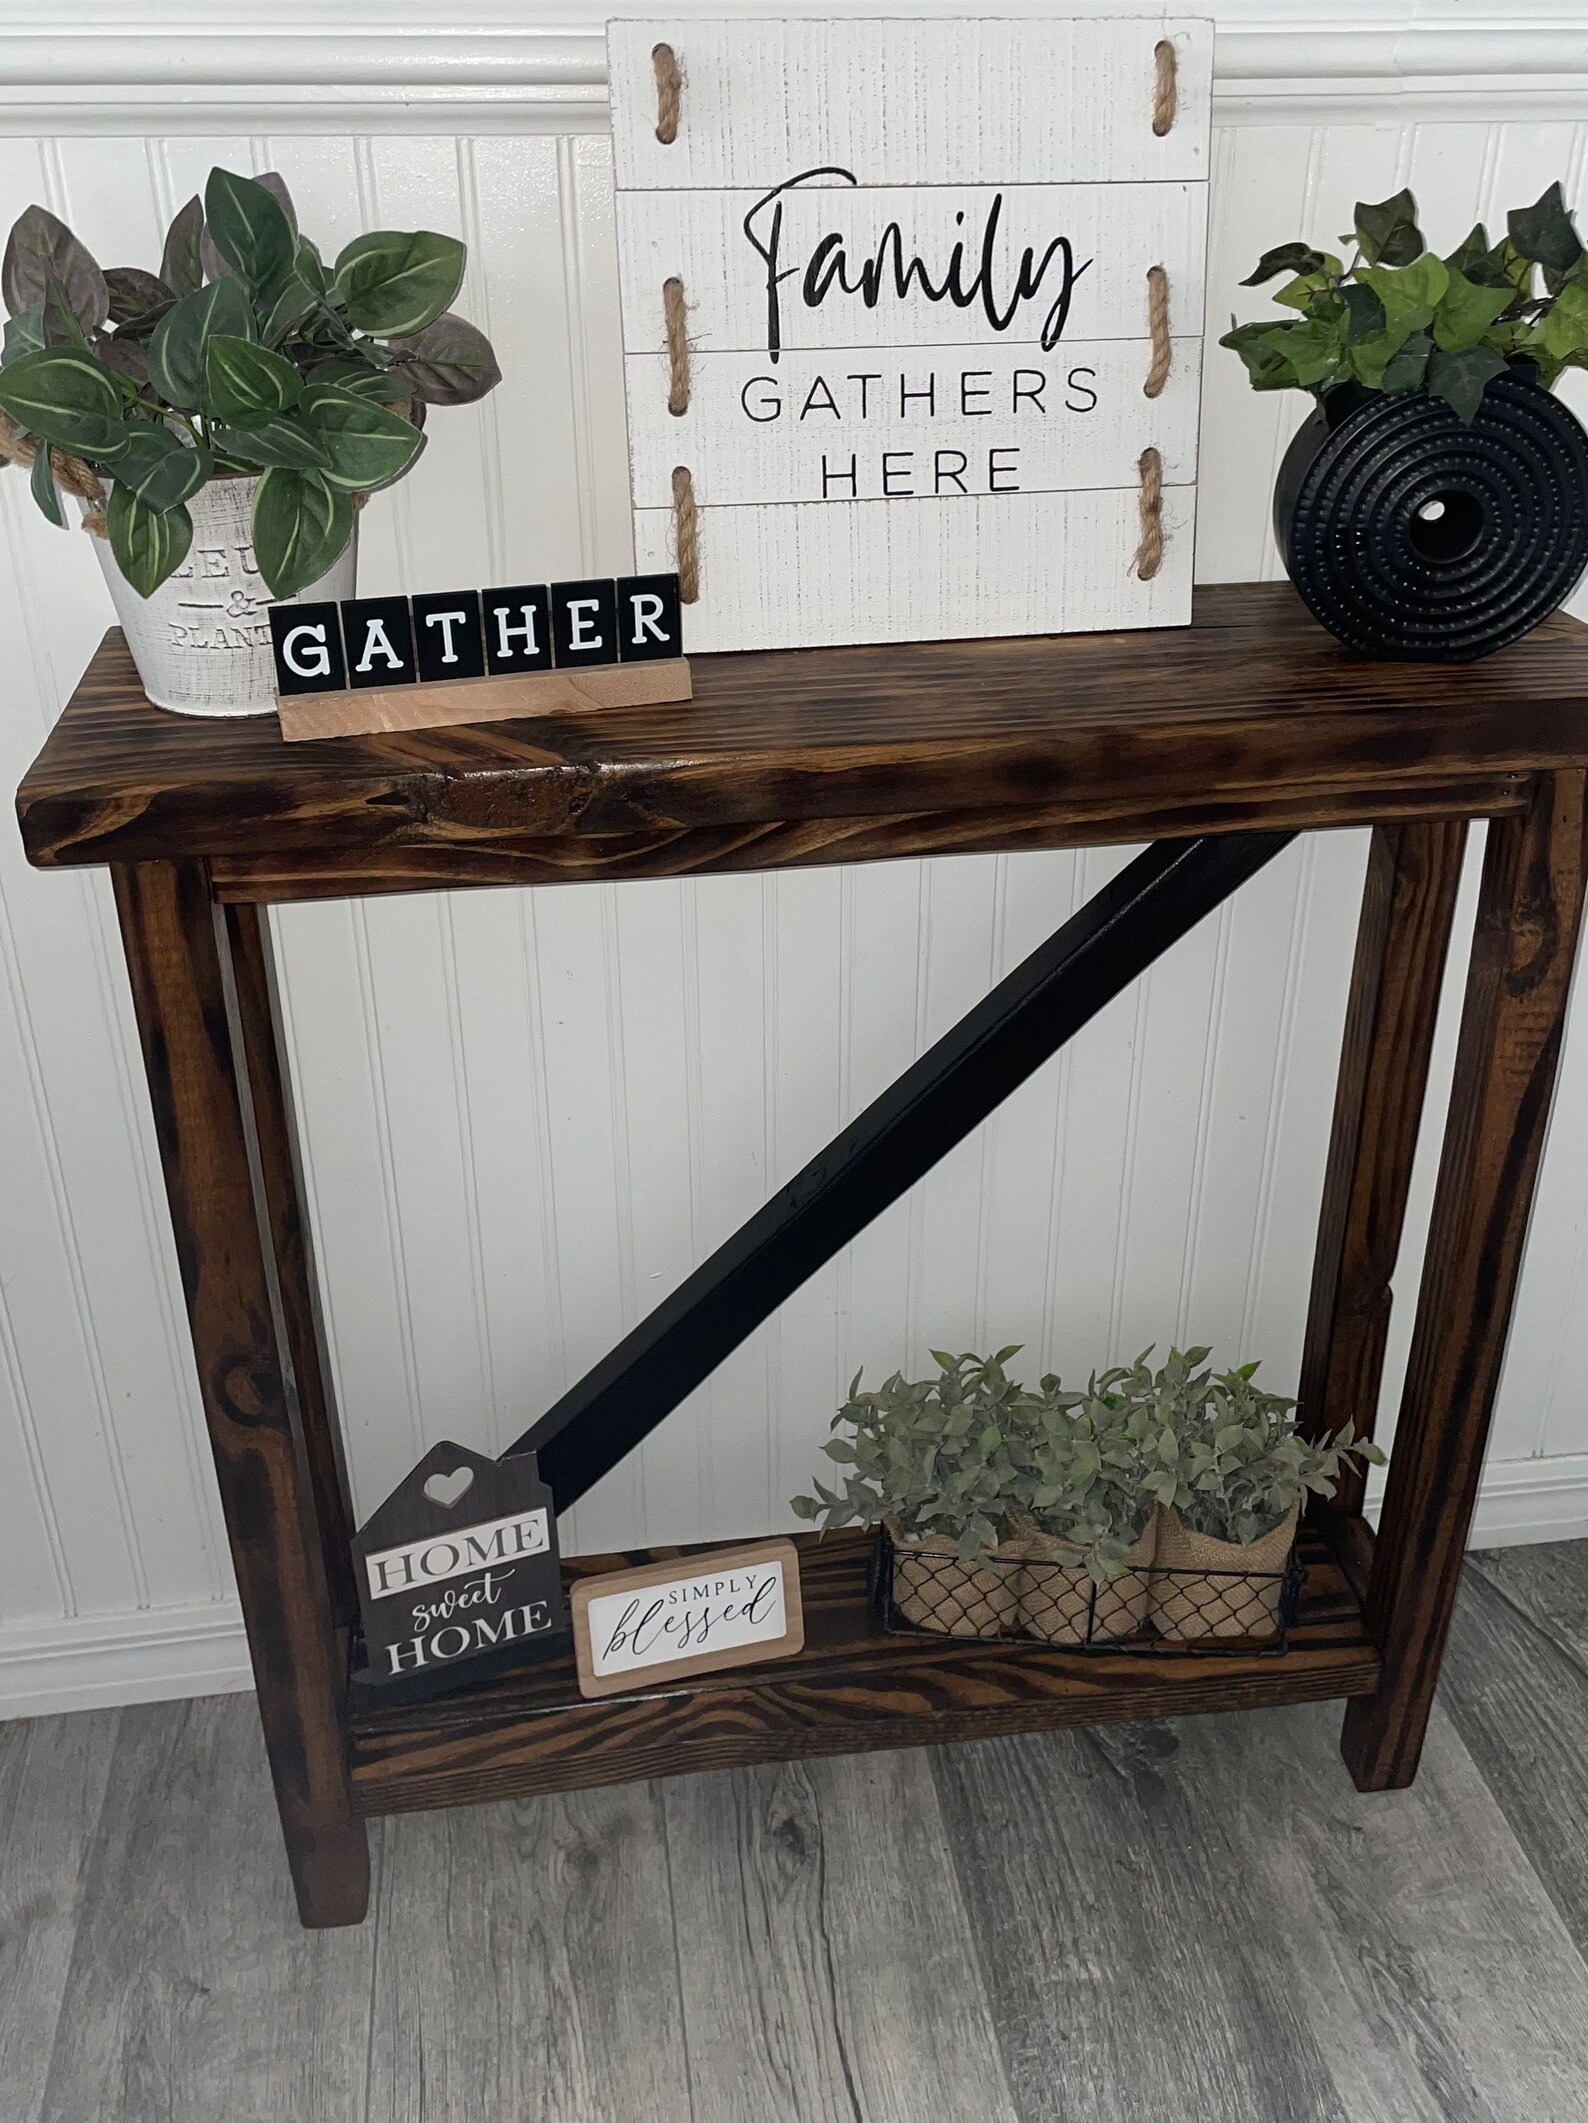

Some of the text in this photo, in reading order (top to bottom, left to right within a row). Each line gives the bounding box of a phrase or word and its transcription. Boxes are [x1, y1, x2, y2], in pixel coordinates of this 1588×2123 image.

[744, 166, 1094, 364] Family
[741, 367, 1098, 423] GATHERS
[822, 447, 1021, 499] HERE
[168, 623, 273, 650] PLANT
[282, 593, 671, 678] GATHER
[373, 1519, 544, 1593] HOME
[668, 1574, 758, 1605] SIMPLY
[411, 1568, 516, 1633] sweet
[602, 1576, 777, 1661] blessed
[384, 1600, 552, 1676] HOME
